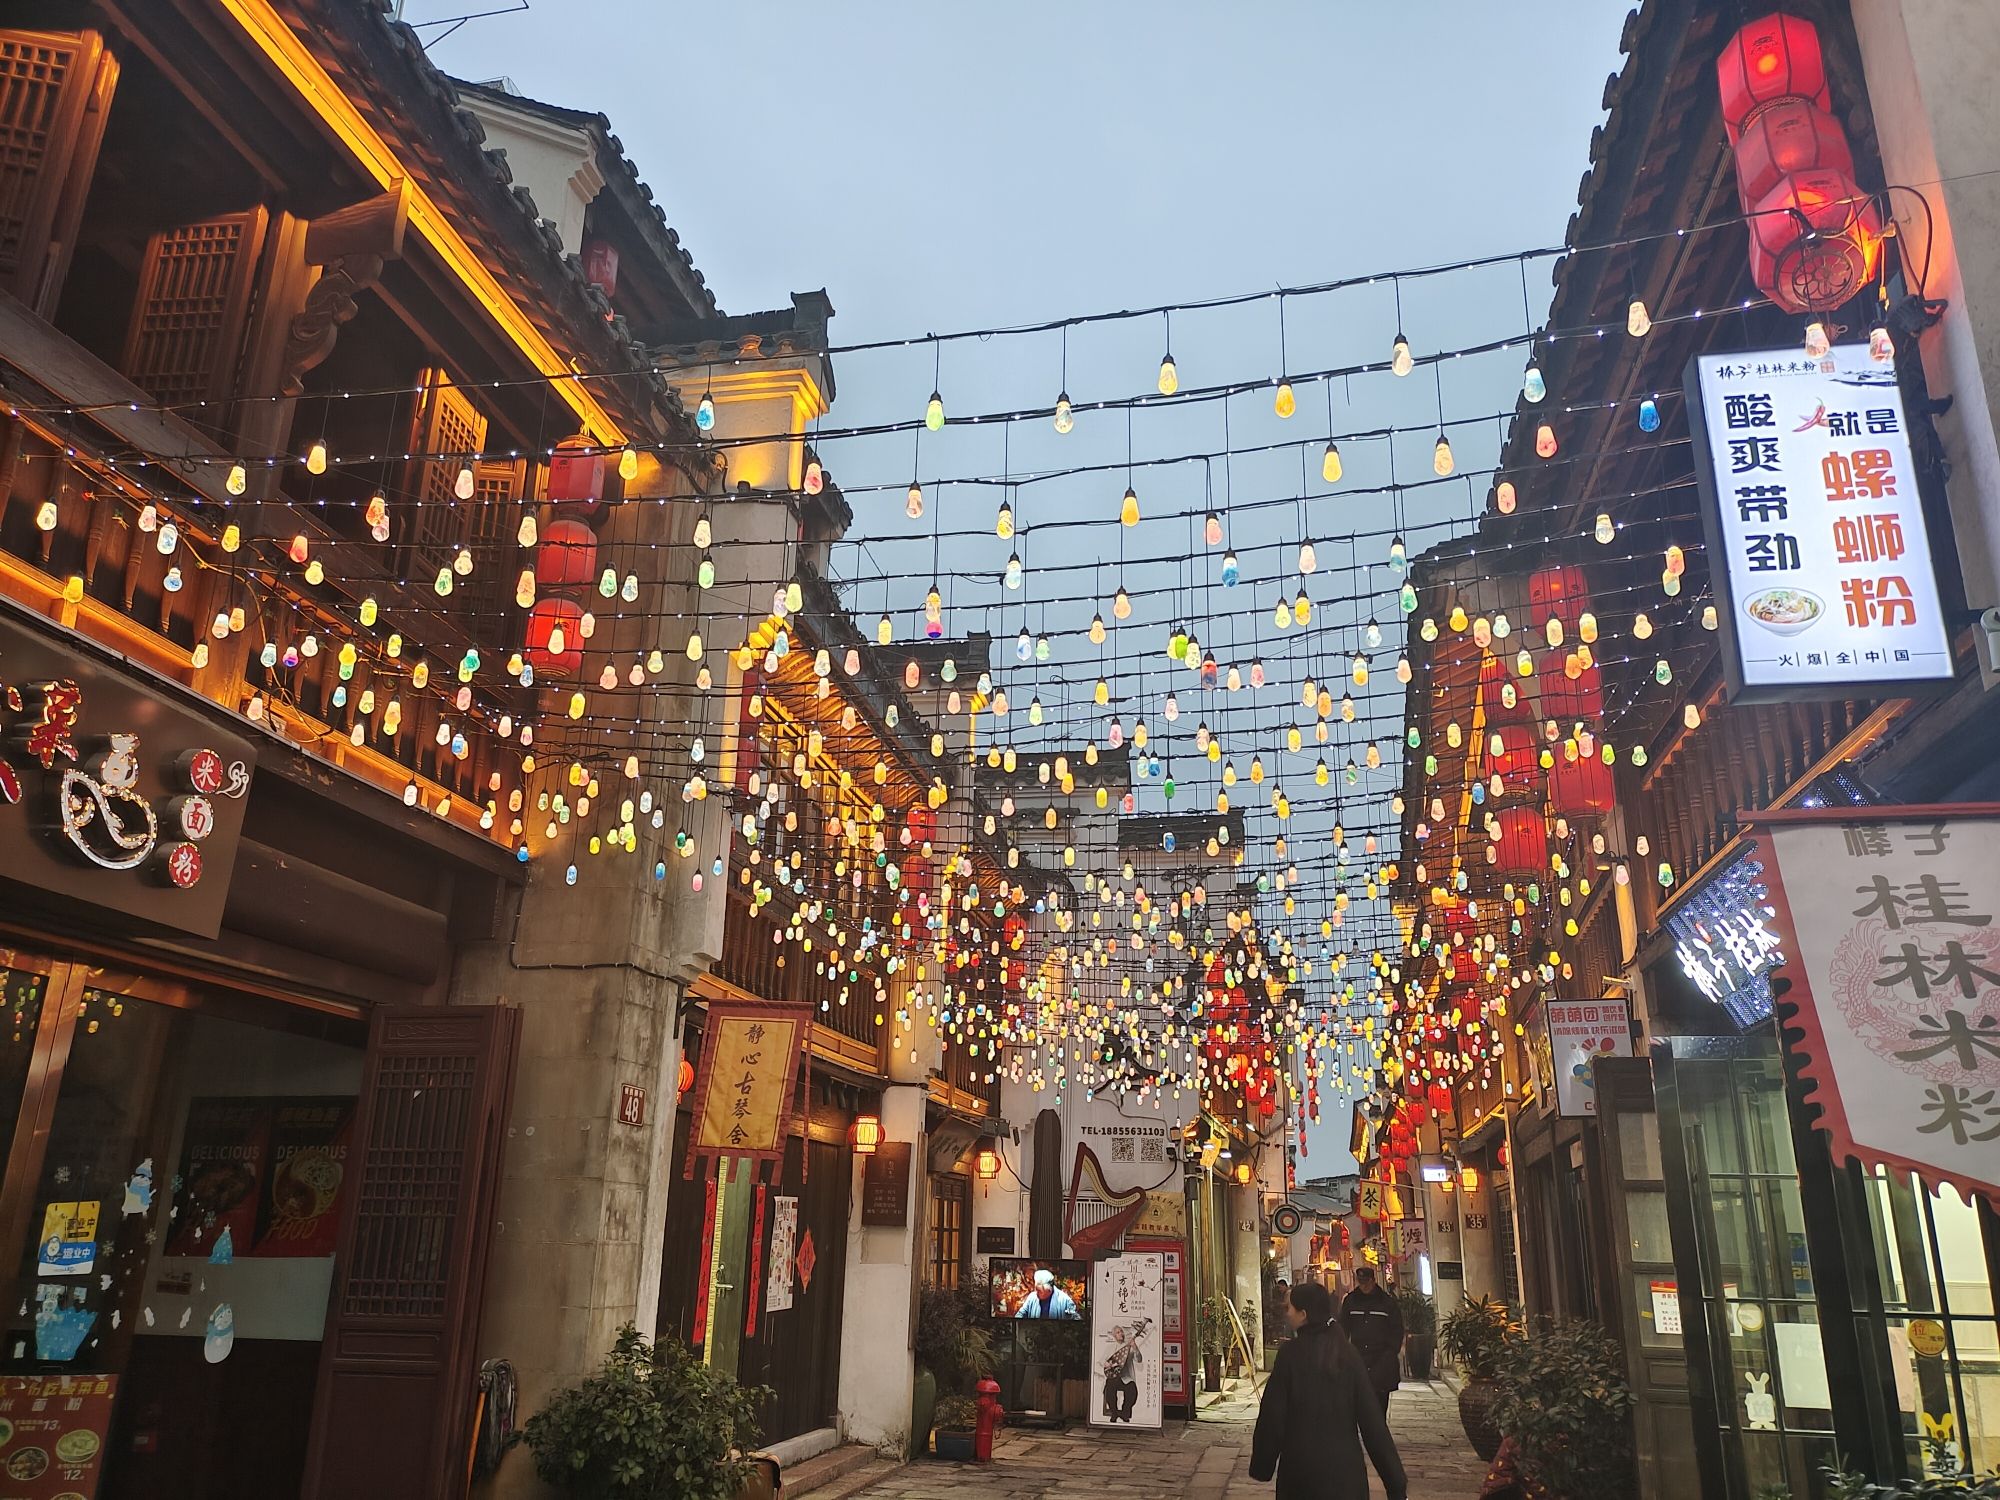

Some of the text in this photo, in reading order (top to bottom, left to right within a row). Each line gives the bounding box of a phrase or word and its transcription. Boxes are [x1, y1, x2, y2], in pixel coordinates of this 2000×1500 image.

[1756, 361, 1817, 376] 桂林米粉
[1827, 408, 1900, 437] 就是
[1724, 393, 1802, 572] 酸爽带劲
[1821, 448, 1917, 628] 螺蛳粉
[1550, 1006, 1599, 1023] 萌萌团
[1852, 873, 2000, 1146] 桂林米粉
[726, 1023, 766, 1145] 静心古琴舍
[624, 1095, 640, 1123] 48
[191, 1145, 260, 1160] DELICIOUS
[277, 1145, 348, 1160] DEOUS
[1363, 1187, 1380, 1210] 茶
[1241, 1222, 1251, 1232] 42
[1470, 1217, 1483, 1229] 35
[1406, 1228, 1424, 1245] 煙
